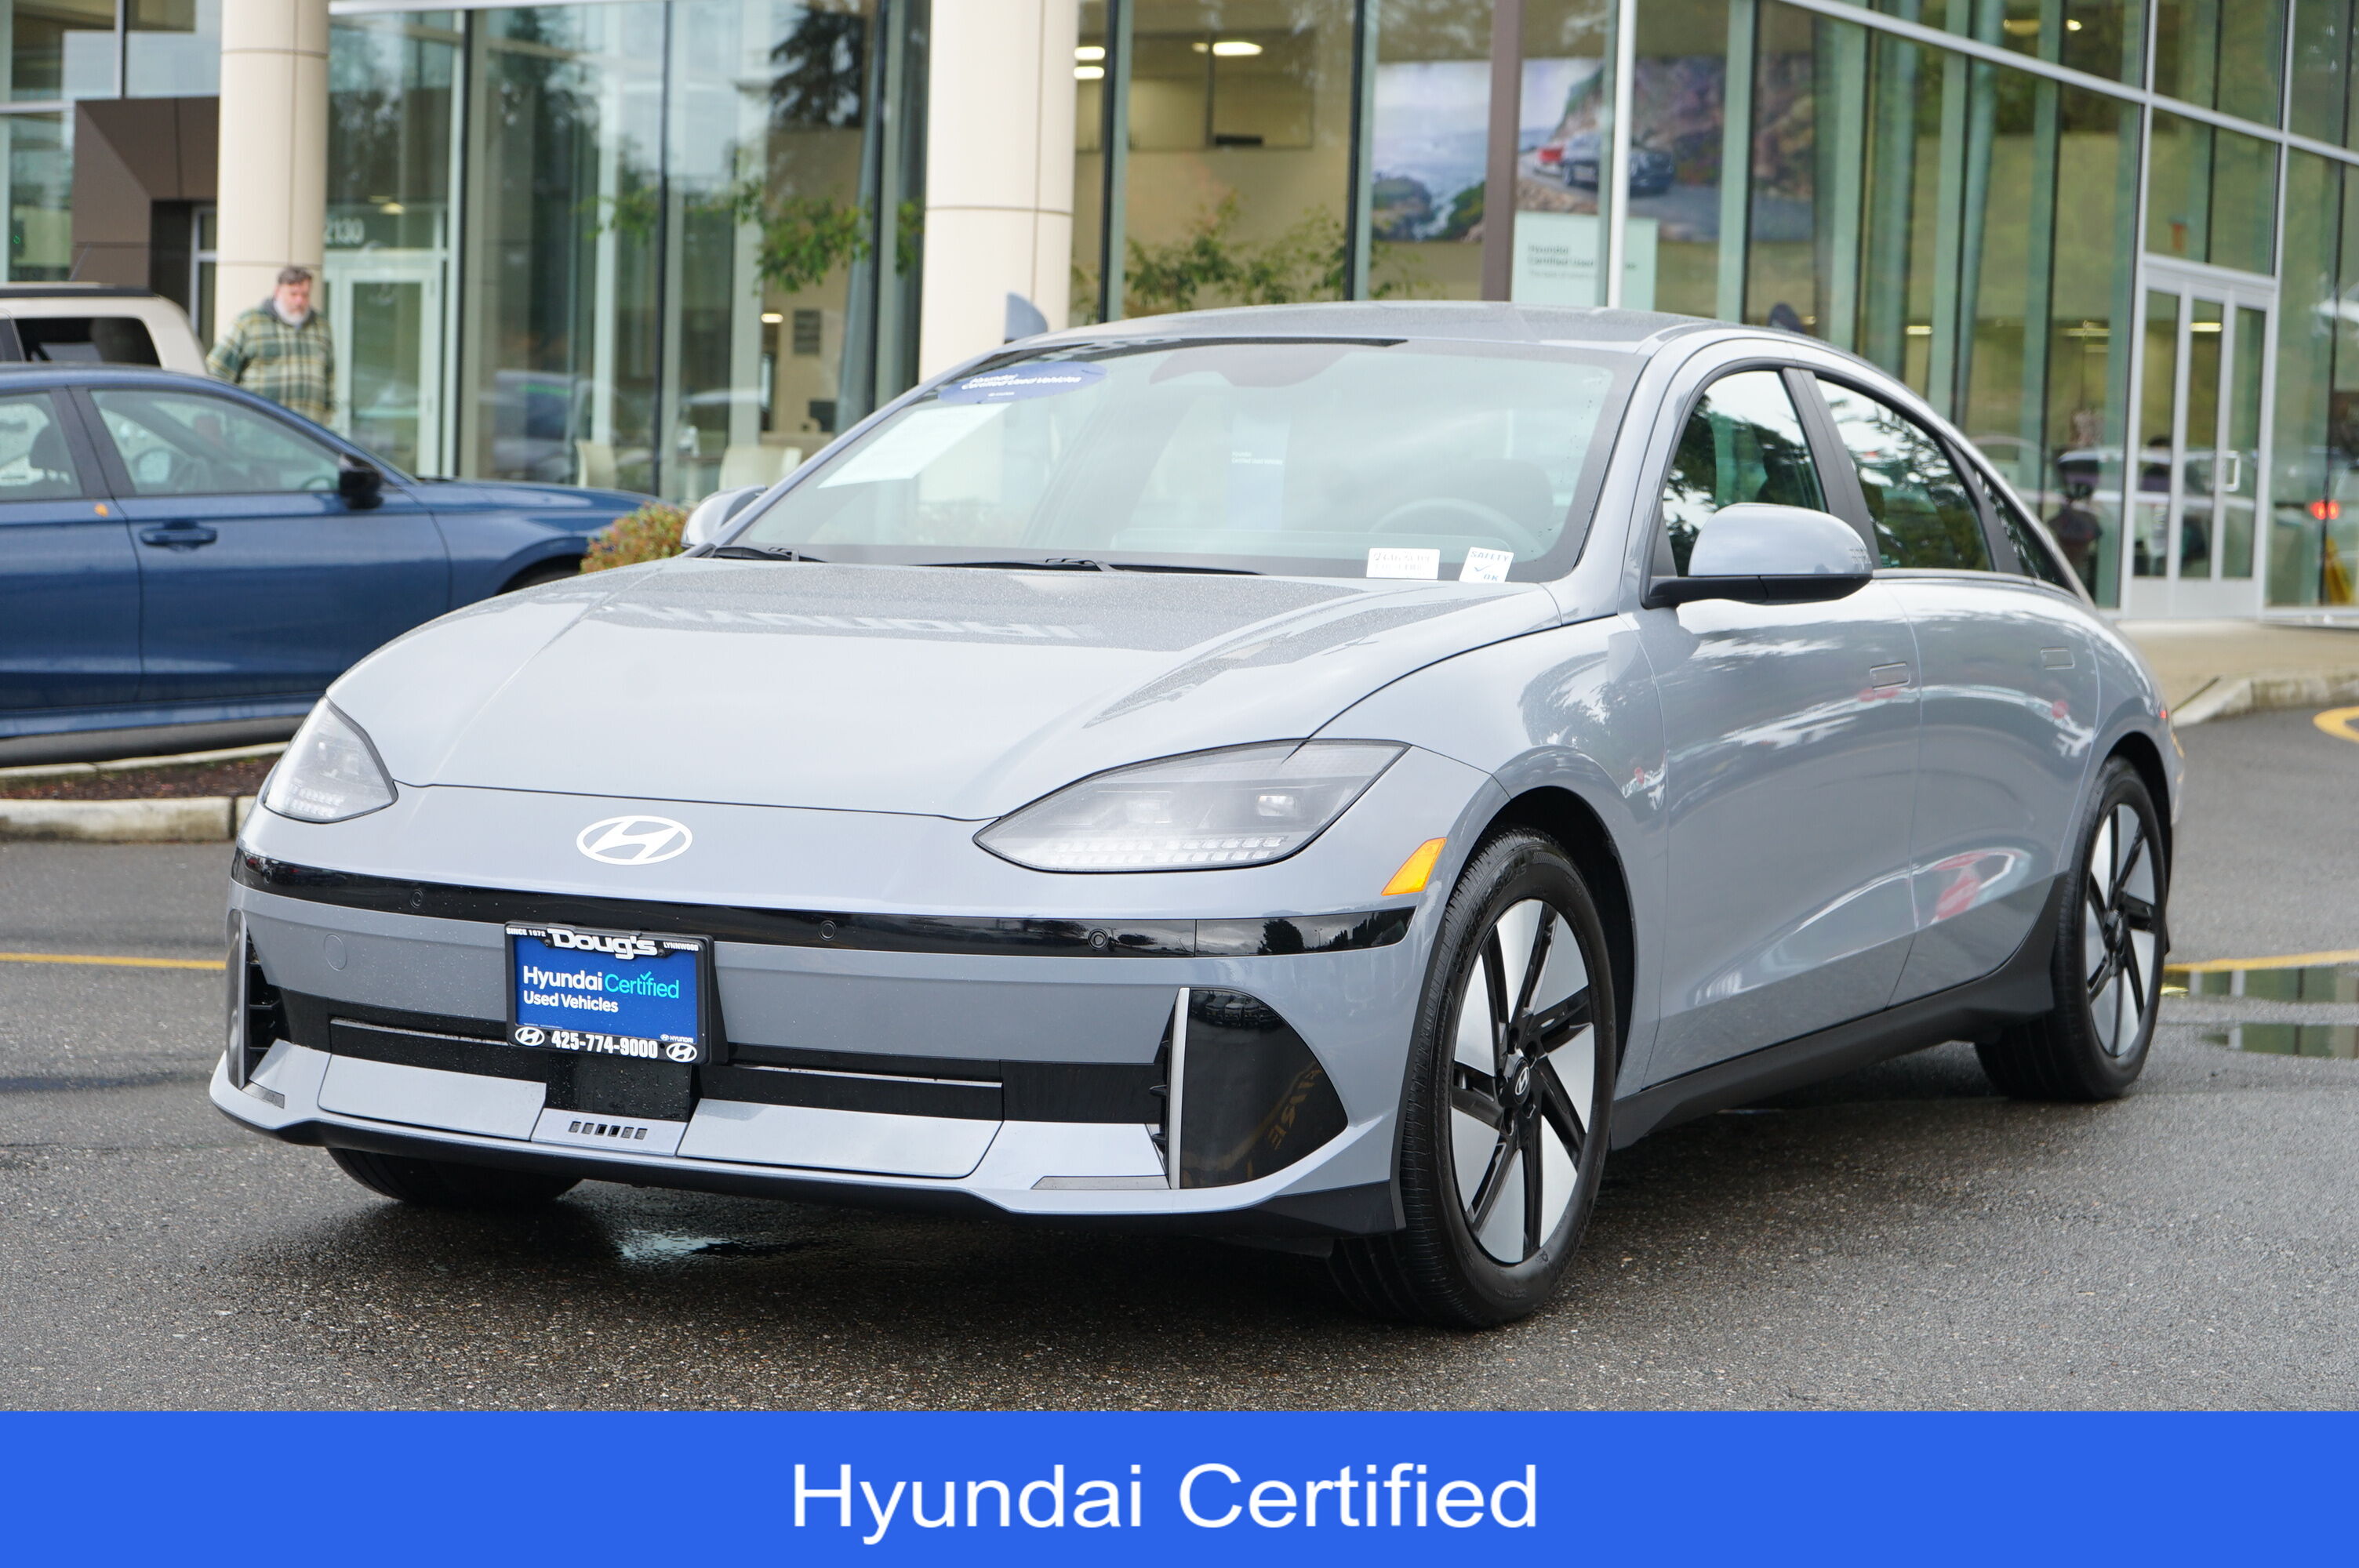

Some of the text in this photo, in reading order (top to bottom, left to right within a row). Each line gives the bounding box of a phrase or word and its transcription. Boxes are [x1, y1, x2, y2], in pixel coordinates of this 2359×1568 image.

[506, 927, 527, 936] SINCE
[547, 927, 658, 960] Doug's
[663, 941, 699, 951] LYNNWOOD
[523, 965, 679, 999] Hyundai Certified
[523, 989, 619, 1013] Used Vehicles
[551, 1030, 658, 1059] 425-774-9000
[670, 1035, 694, 1044] HYUNDAI
